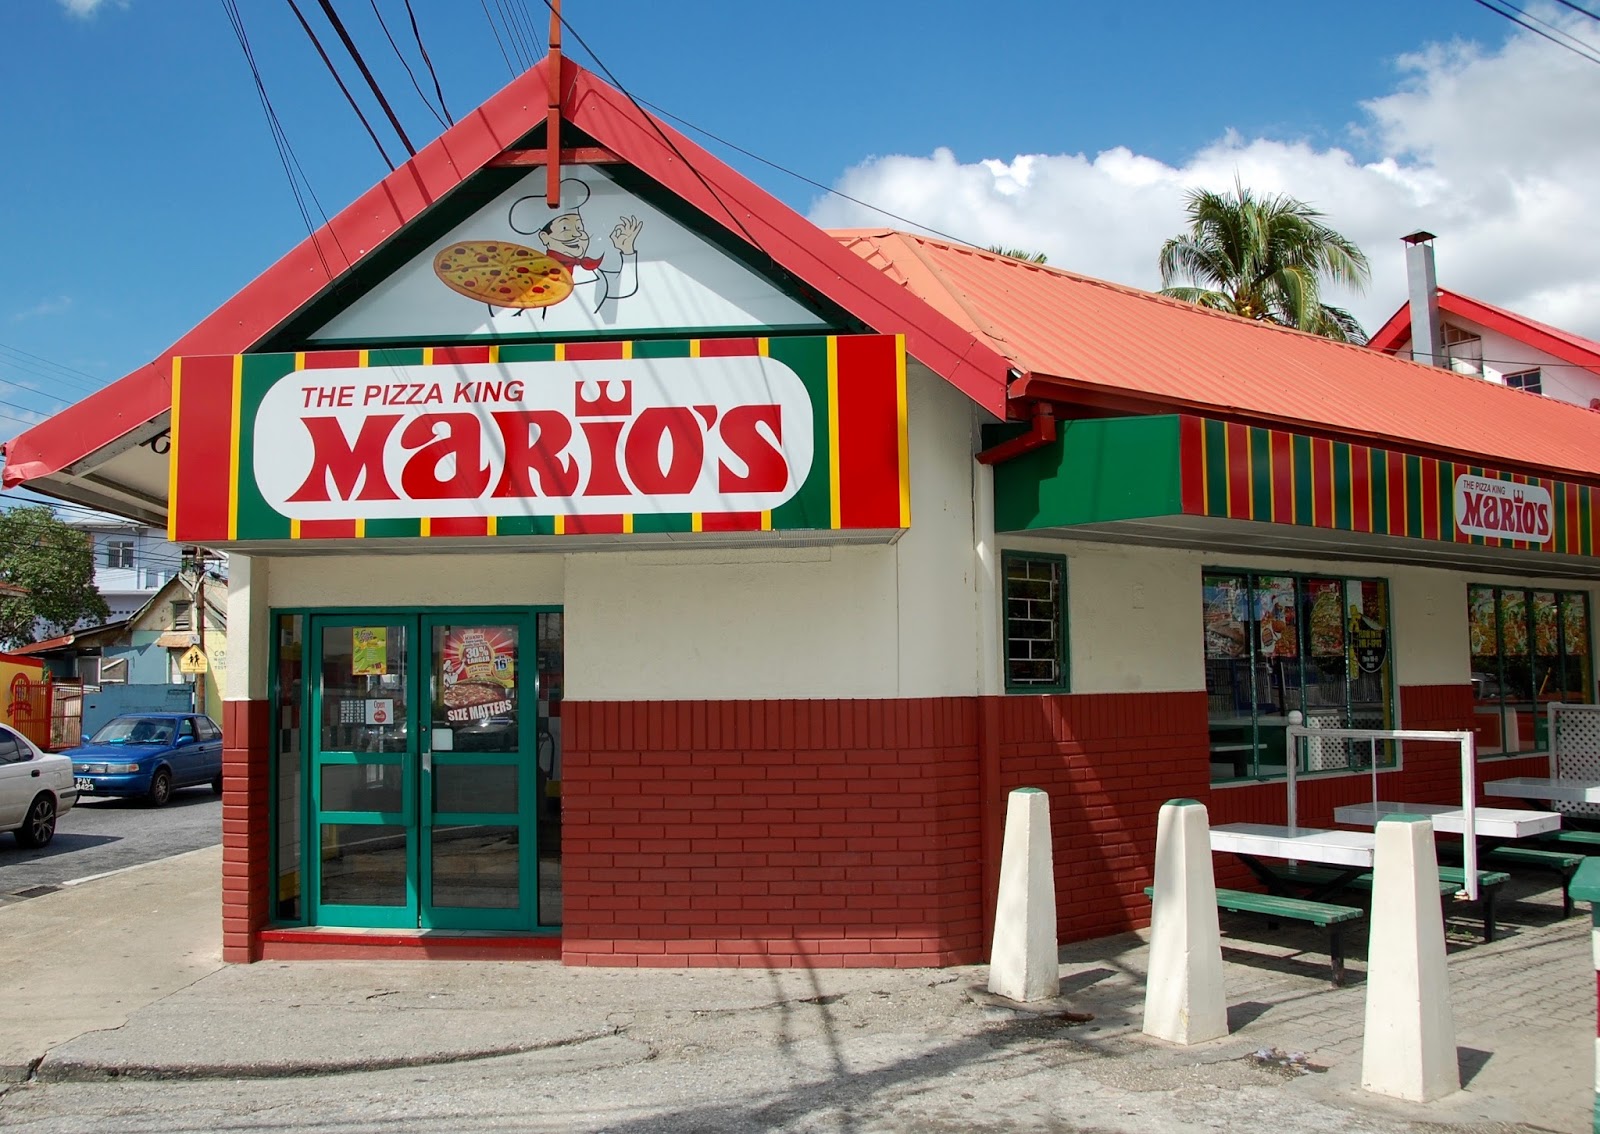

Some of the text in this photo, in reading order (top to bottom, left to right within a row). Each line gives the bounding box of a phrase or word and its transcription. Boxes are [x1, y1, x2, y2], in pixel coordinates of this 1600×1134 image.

[301, 380, 524, 408] THE PIZZA KING
[1463, 479, 1506, 495] THE PIZZA KING
[465, 647, 488, 658] 30%
[447, 700, 512, 721] SIZE MATTERS
